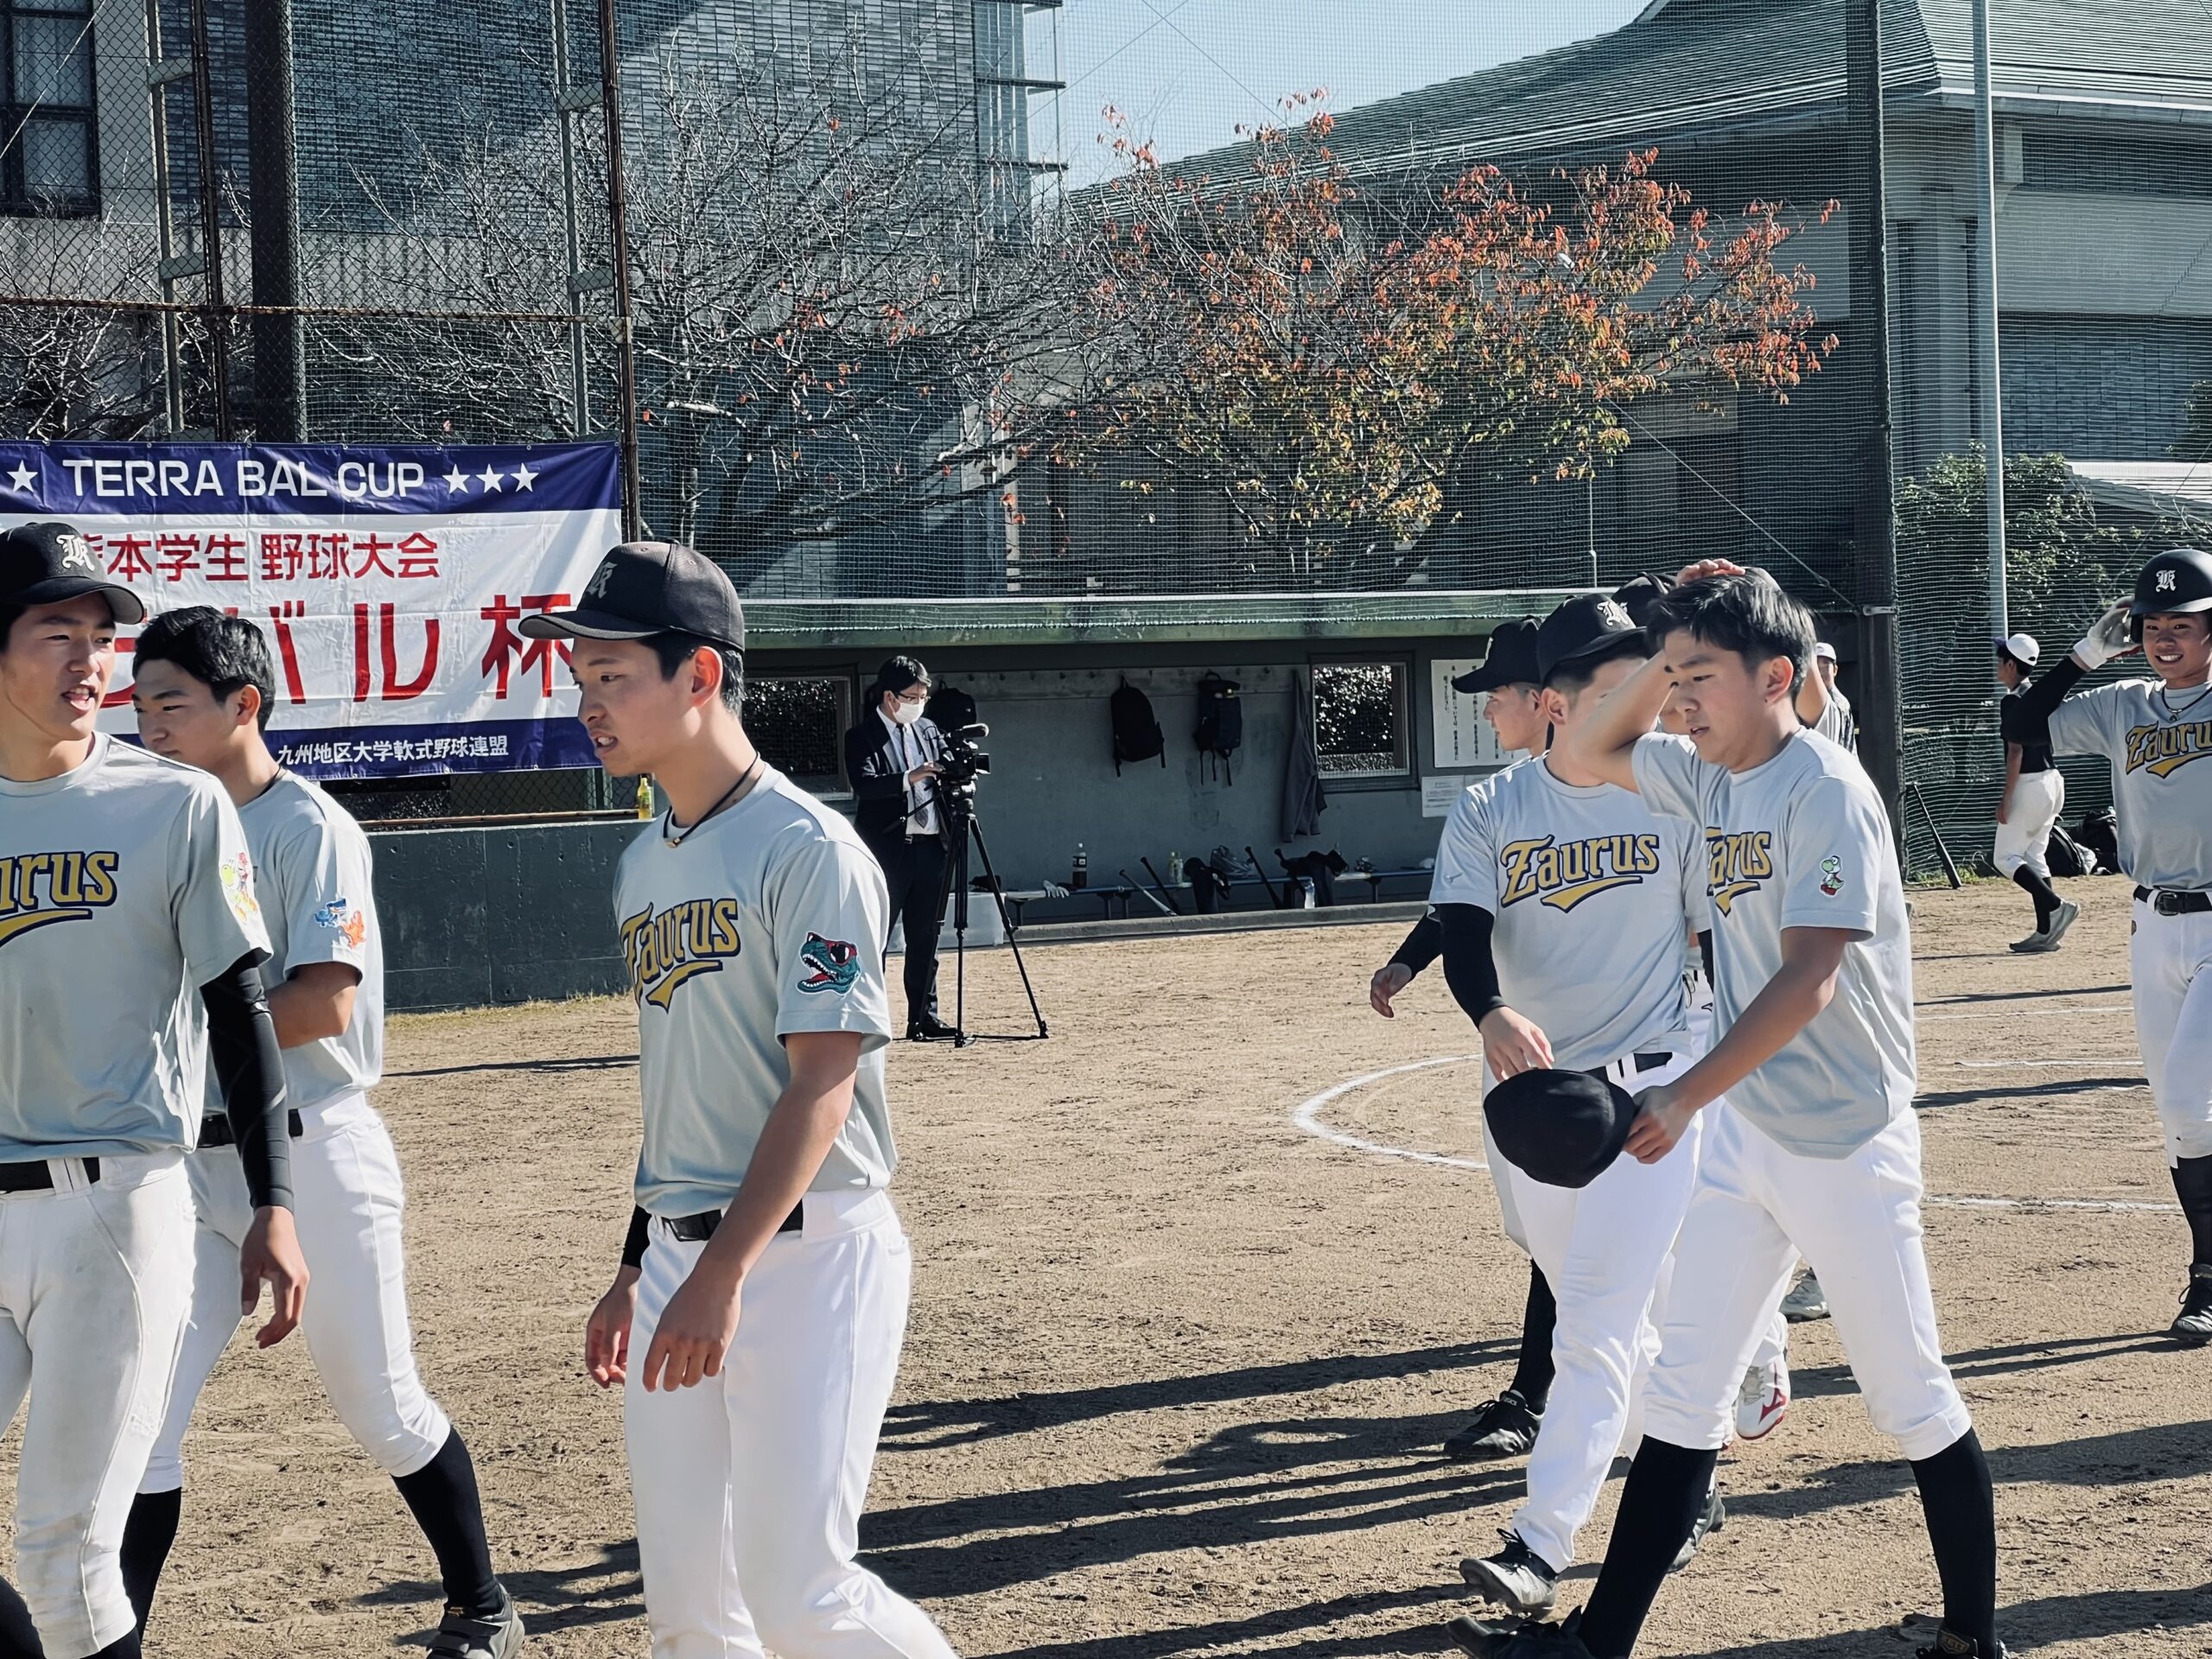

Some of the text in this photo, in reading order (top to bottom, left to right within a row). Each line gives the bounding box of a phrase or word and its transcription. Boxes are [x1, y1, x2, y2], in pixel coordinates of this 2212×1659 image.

[62, 460, 424, 499] TERRA BAL CUP
[277, 734, 509, 766] 九州地区大学軟式野球連盟
[1501, 834, 1659, 908] Taurus
[620, 898, 741, 1009] Taurus
